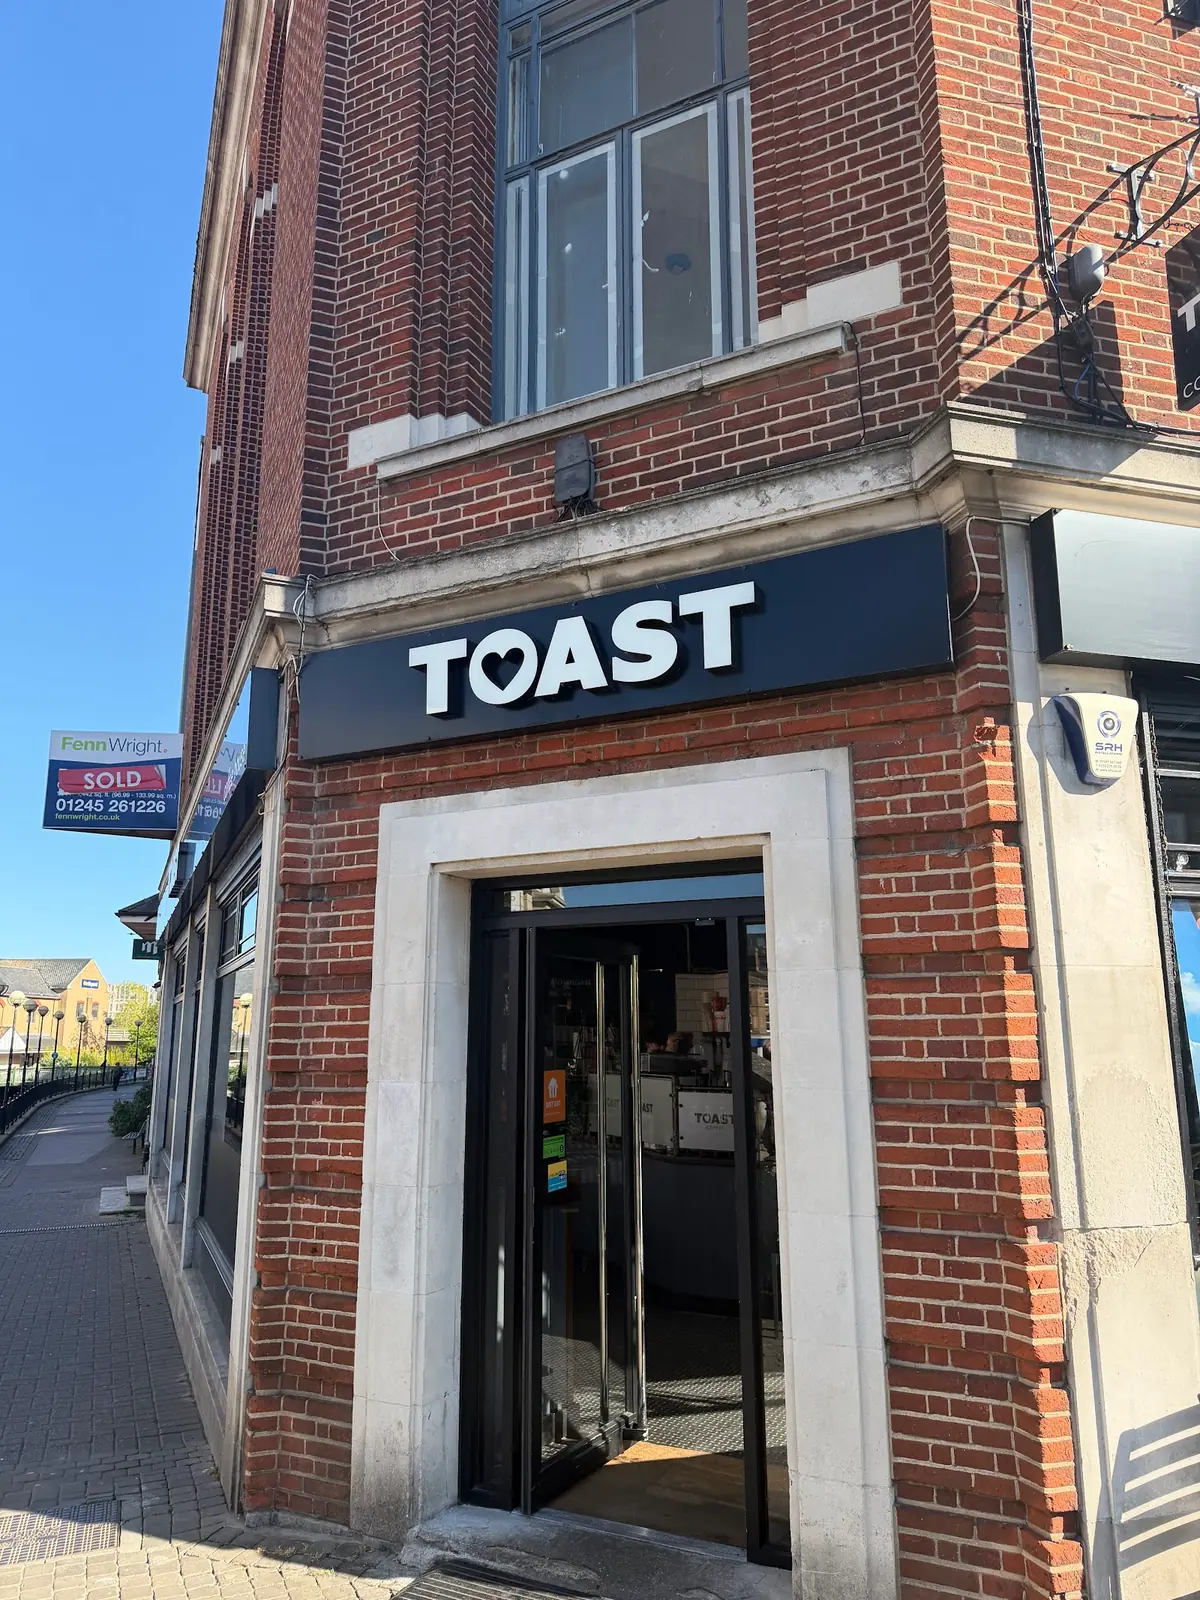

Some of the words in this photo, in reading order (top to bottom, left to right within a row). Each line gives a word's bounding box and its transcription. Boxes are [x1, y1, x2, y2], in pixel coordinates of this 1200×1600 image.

[409, 581, 755, 715] TOAST
[1095, 743, 1122, 752] SRH
[83, 770, 142, 790] SOLD
[56, 798, 104, 812] 01245
[108, 800, 166, 813] 261226
[55, 812, 120, 822] fennwright.co.uk
